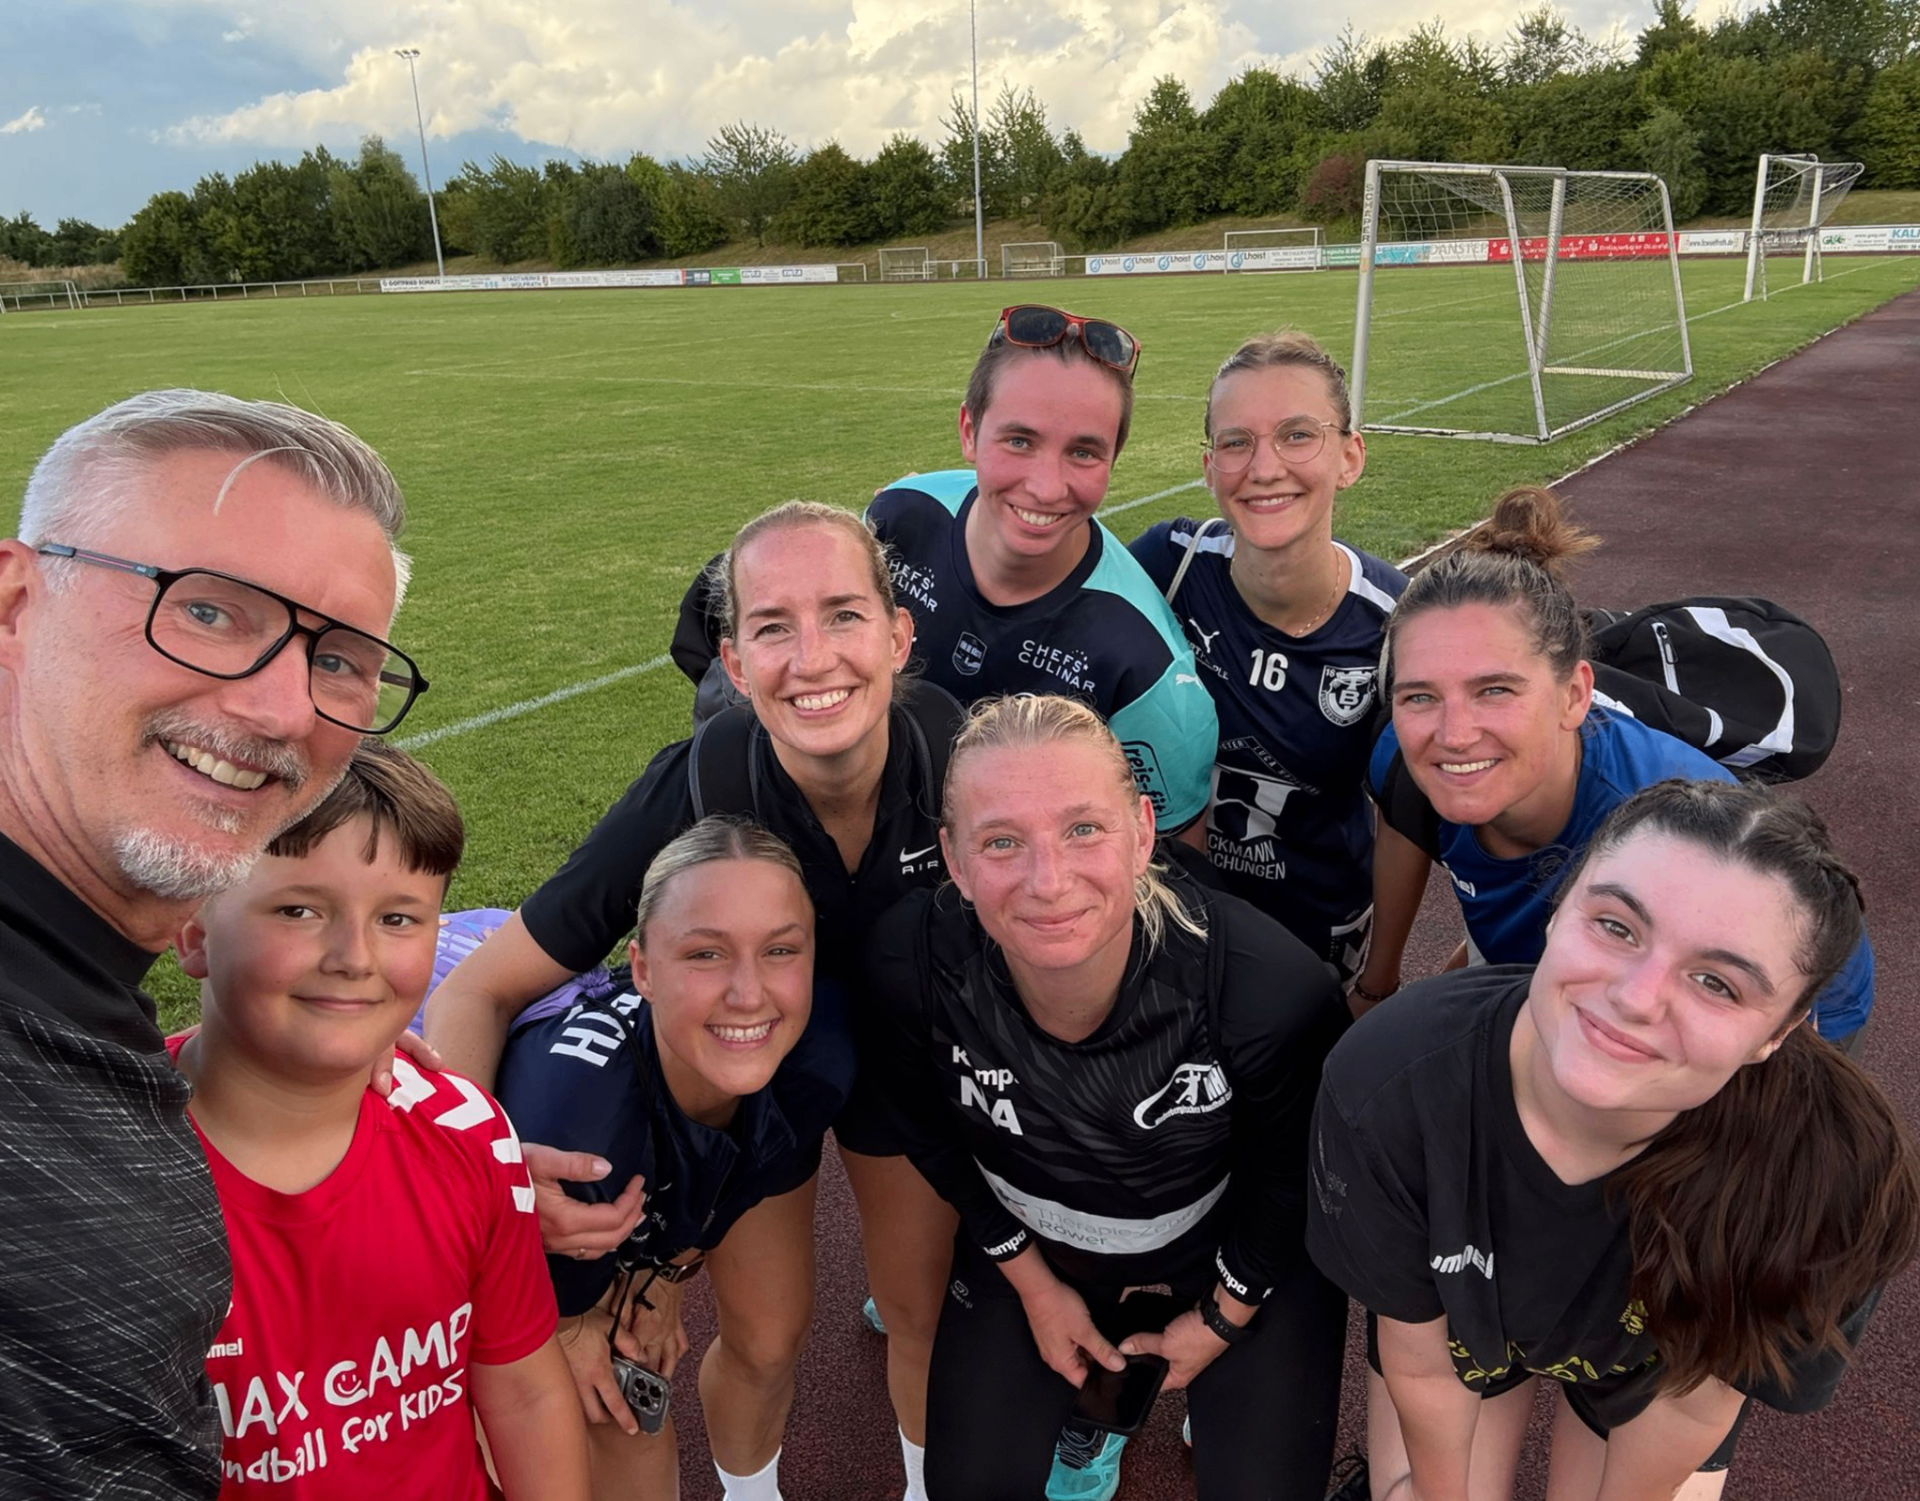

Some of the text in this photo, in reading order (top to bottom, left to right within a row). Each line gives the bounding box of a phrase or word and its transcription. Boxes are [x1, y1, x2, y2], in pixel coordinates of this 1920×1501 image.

[1170, 255, 1191, 263] Lhoist
[1244, 252, 1266, 260] Lhoist
[888, 559, 931, 590] HEFS
[1018, 652, 1096, 692] CULINAR
[1022, 639, 1082, 673] CHEFS
[1249, 648, 1289, 692] 16
[902, 860, 939, 875] AIR
[952, 1045, 1020, 1092] kmp
[323, 1302, 473, 1406] CAMP
[221, 1427, 328, 1484] ndball
[400, 1367, 465, 1431] KIDS
